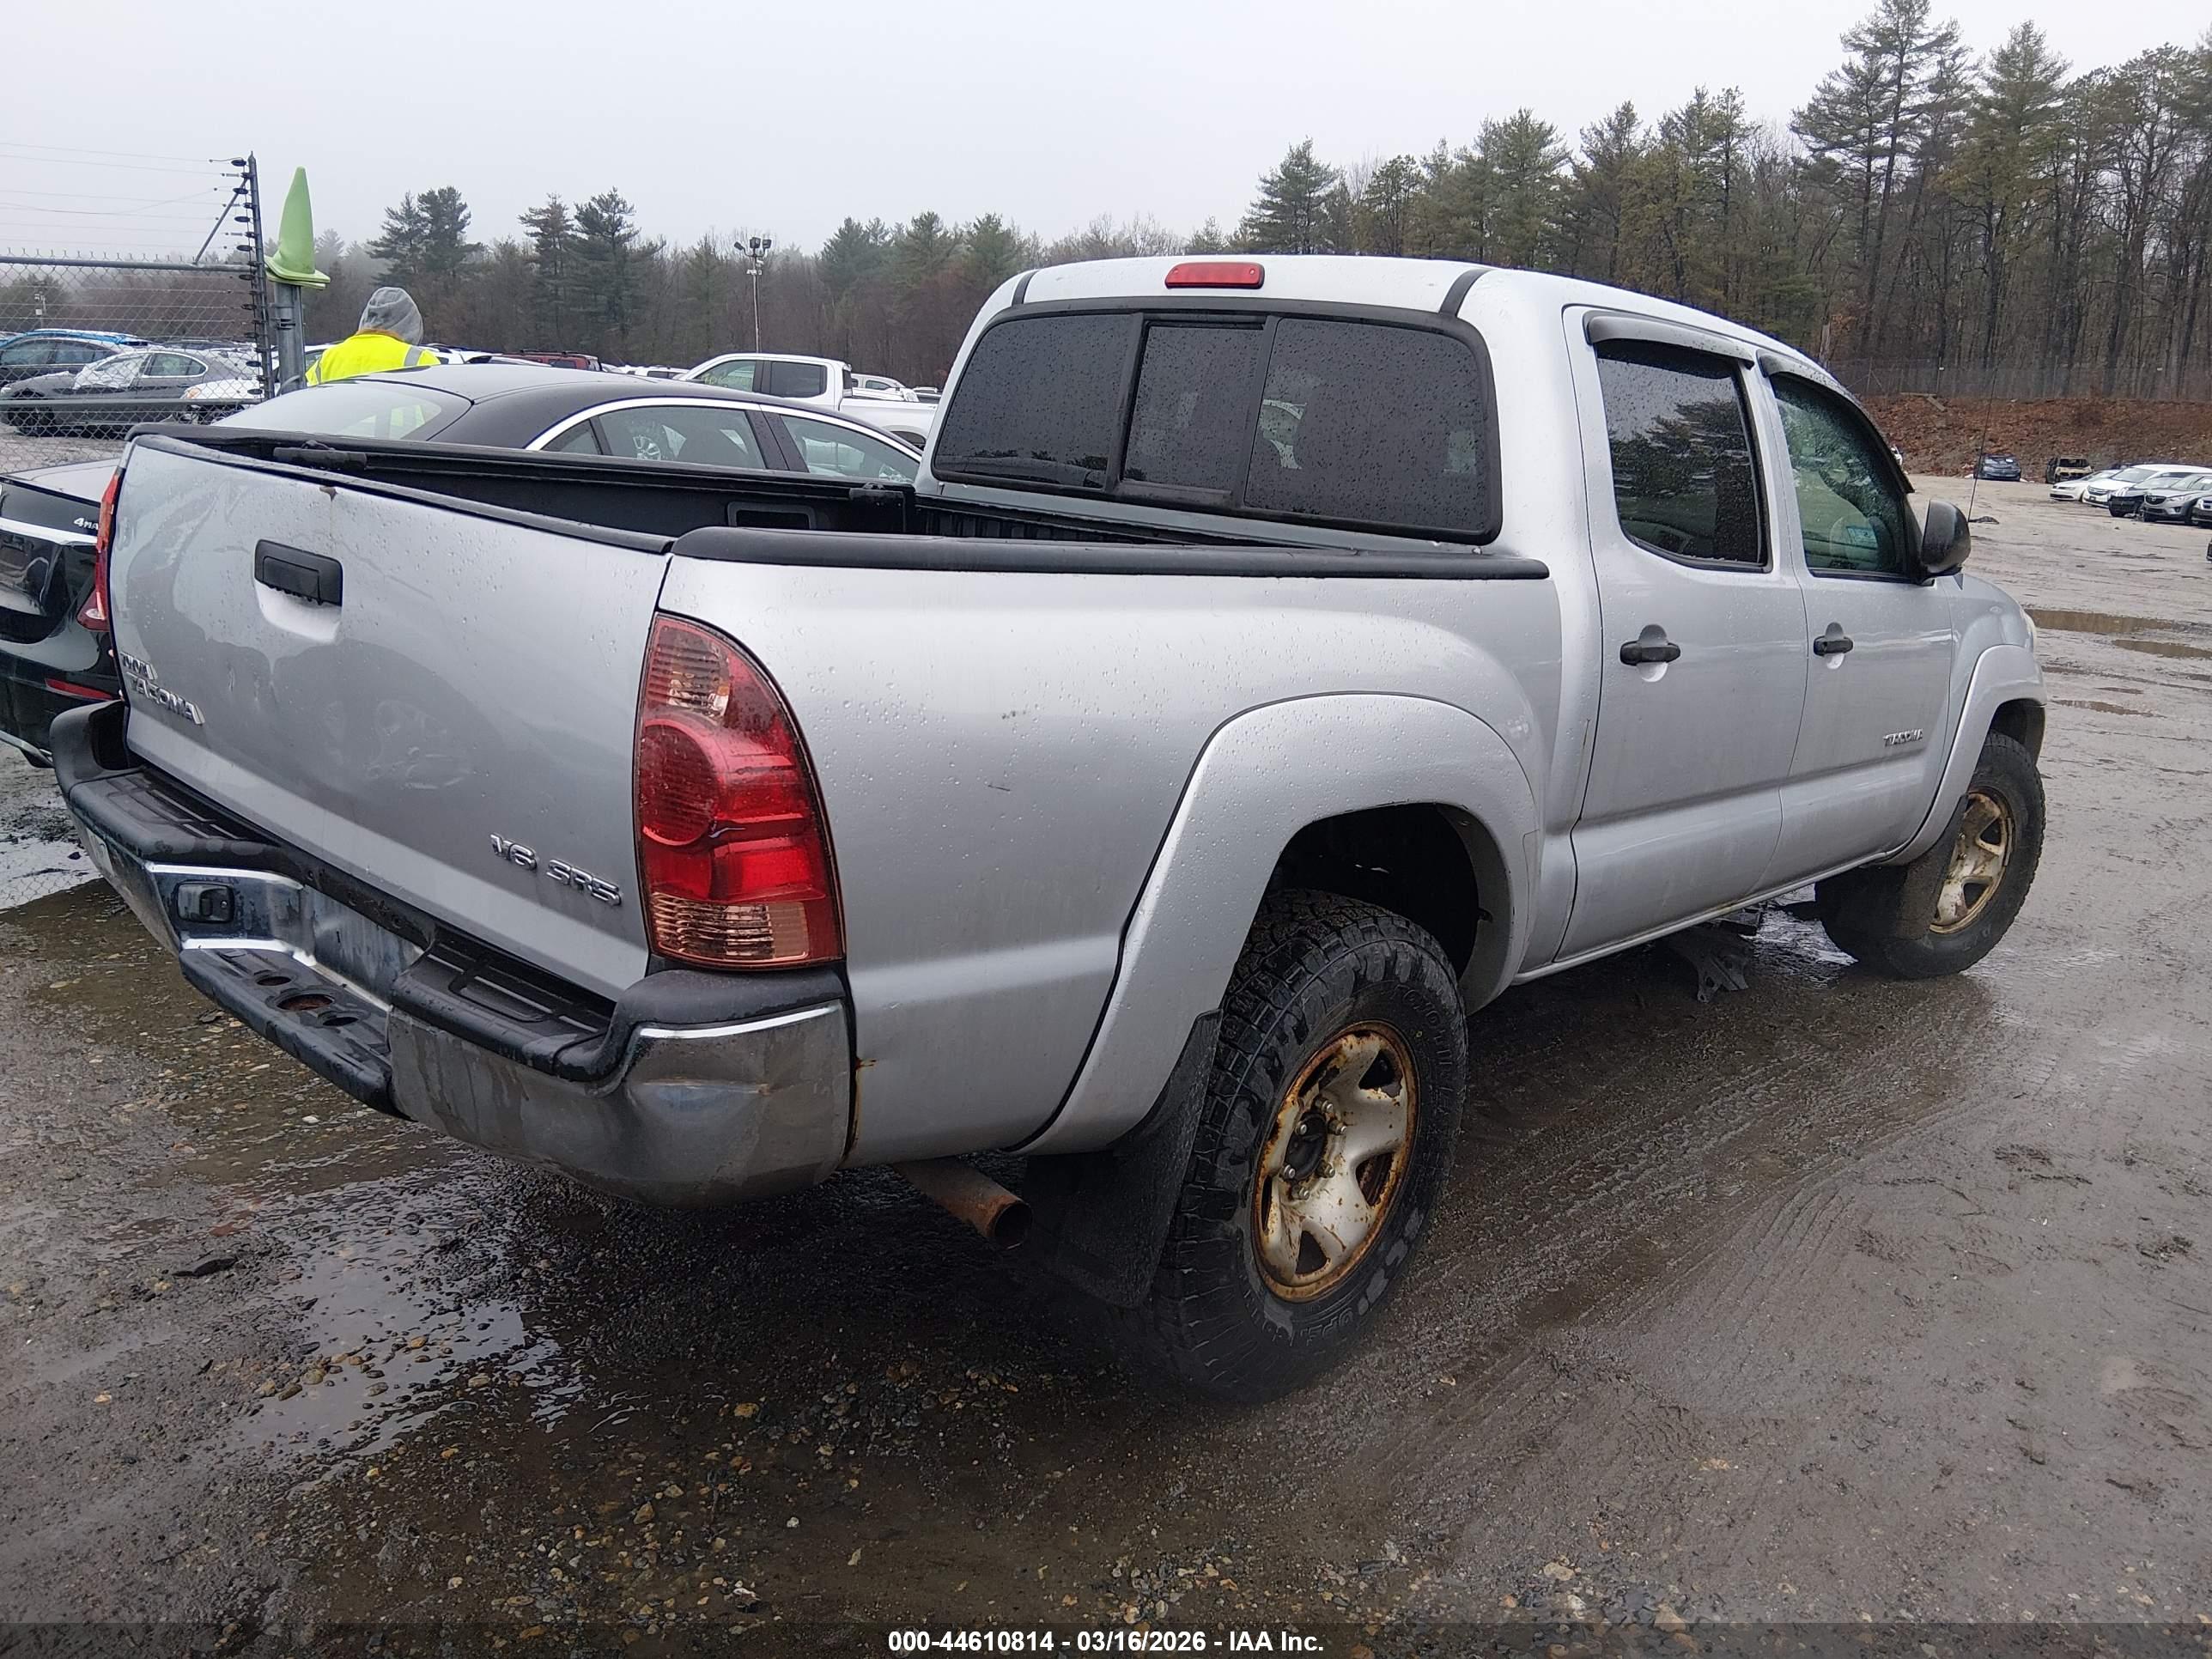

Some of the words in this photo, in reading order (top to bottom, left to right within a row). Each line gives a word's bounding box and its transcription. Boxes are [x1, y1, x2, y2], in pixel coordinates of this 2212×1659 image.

[74, 517, 99, 531] 4MA
[125, 671, 206, 726] TACOMA
[489, 831, 538, 872] V6
[545, 858, 623, 907] SR5
